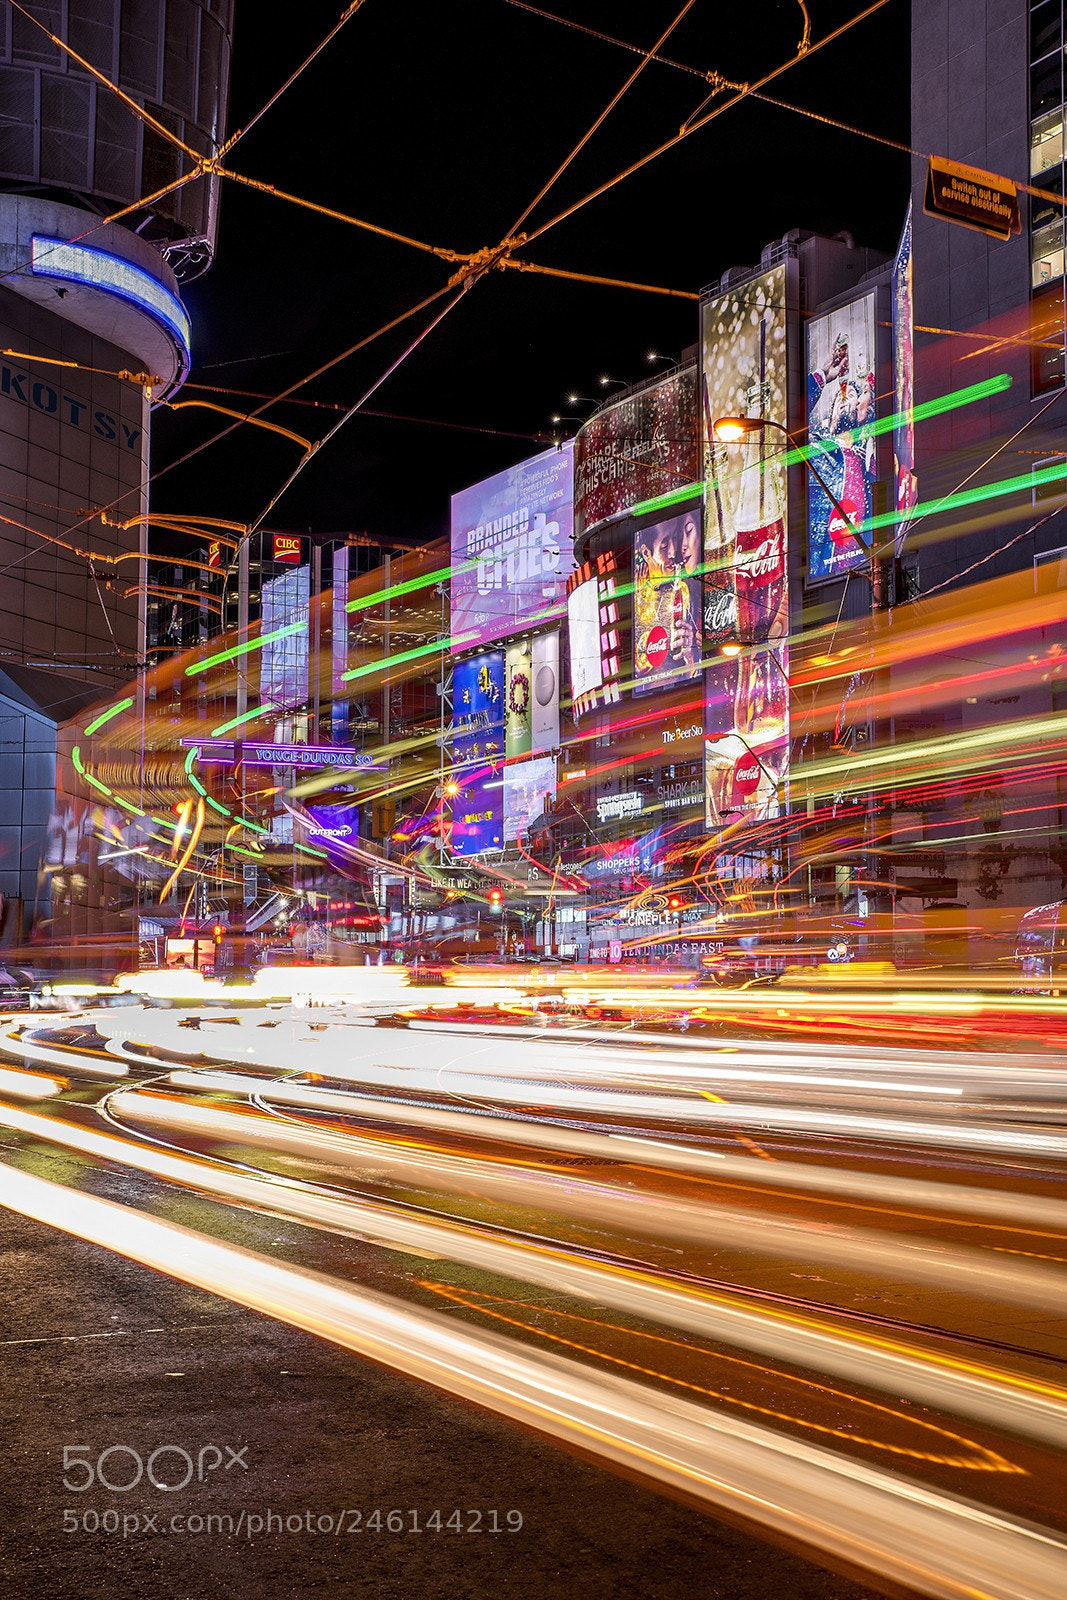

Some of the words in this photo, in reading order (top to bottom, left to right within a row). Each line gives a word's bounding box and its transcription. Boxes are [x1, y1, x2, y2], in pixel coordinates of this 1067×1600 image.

[951, 178, 977, 197] Switch
[979, 188, 991, 201] out
[971, 196, 1012, 220] electrically
[467, 507, 530, 555] BRANDED
[275, 537, 299, 550] CIBC
[646, 637, 668, 655] Coca-Cola
[662, 731, 676, 743] The
[676, 728, 691, 740] Beer
[736, 765, 760, 782] Coca-Cola
[657, 781, 688, 800] SHARK
[664, 799, 681, 808] SPORTS
[681, 797, 691, 806] BAR
[597, 856, 640, 870] SHOPPERS
[610, 946, 620, 959] 10
[691, 941, 724, 954] EAST
